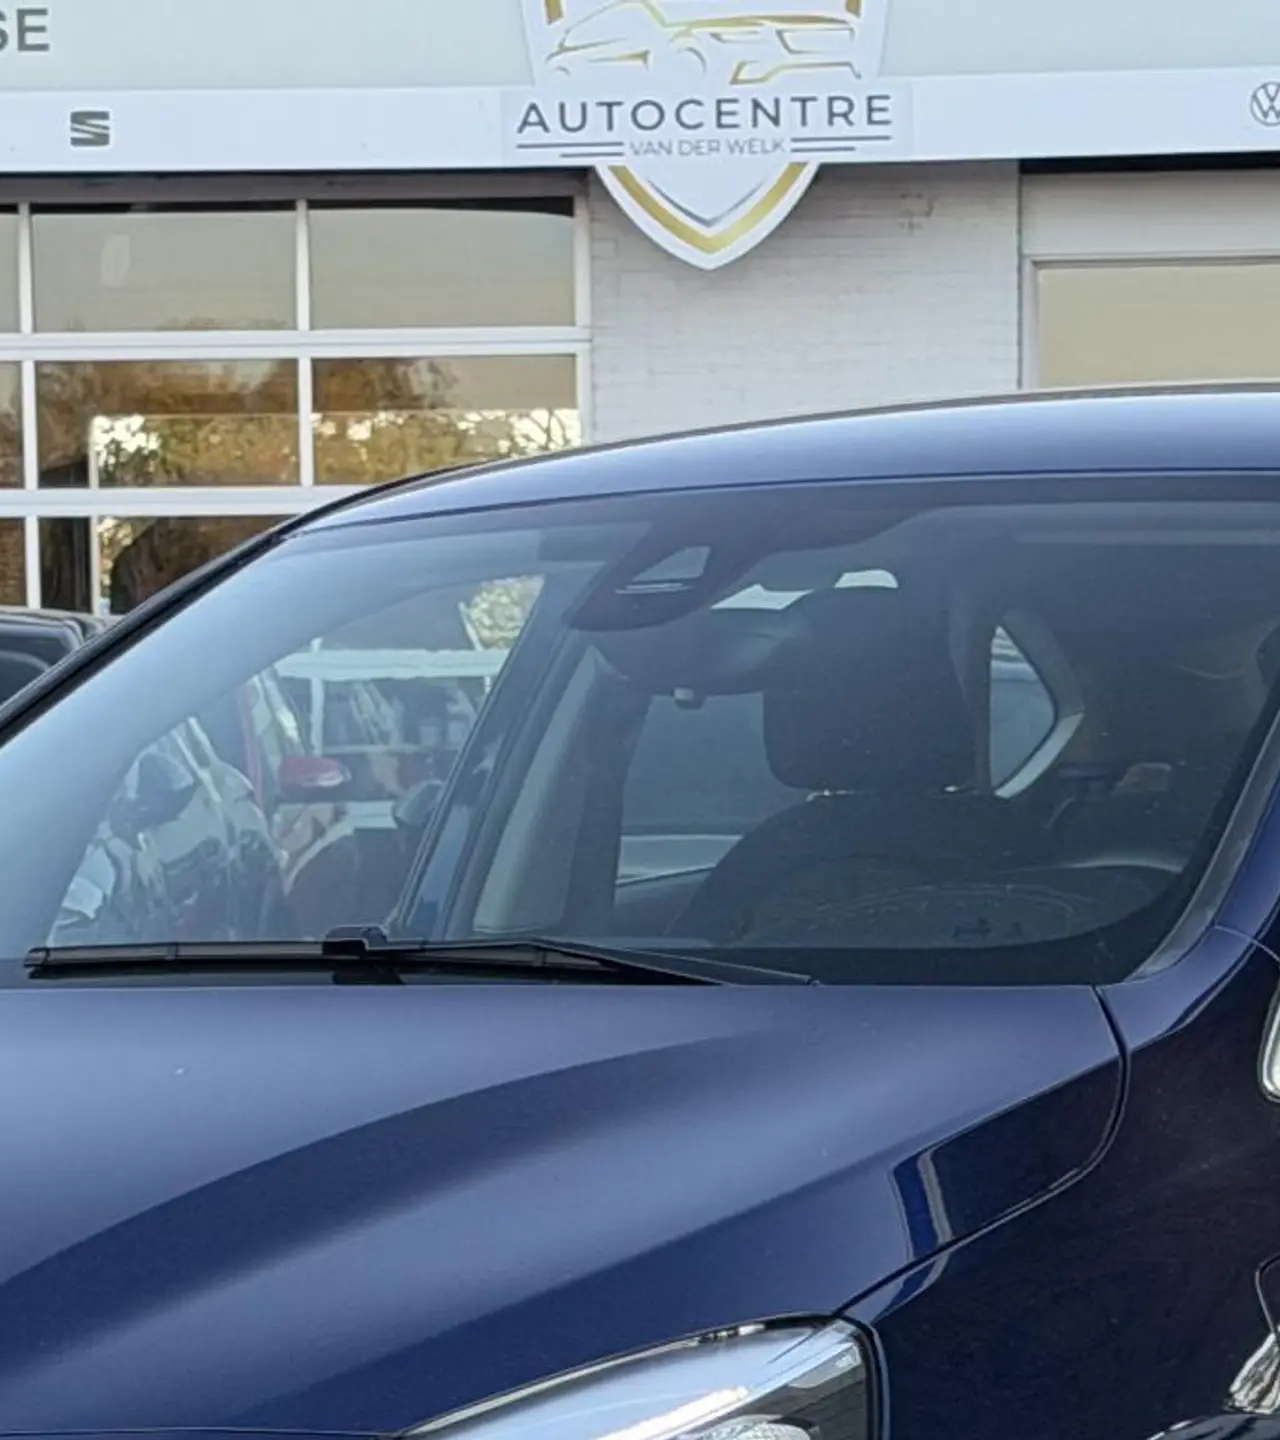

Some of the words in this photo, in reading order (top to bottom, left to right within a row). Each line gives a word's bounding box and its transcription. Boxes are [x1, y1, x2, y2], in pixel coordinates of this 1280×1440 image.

[517, 95, 891, 133] AUTOCENTRE
[629, 140, 673, 157] VAN
[678, 139, 721, 157] DER
[726, 137, 785, 155] WELK
